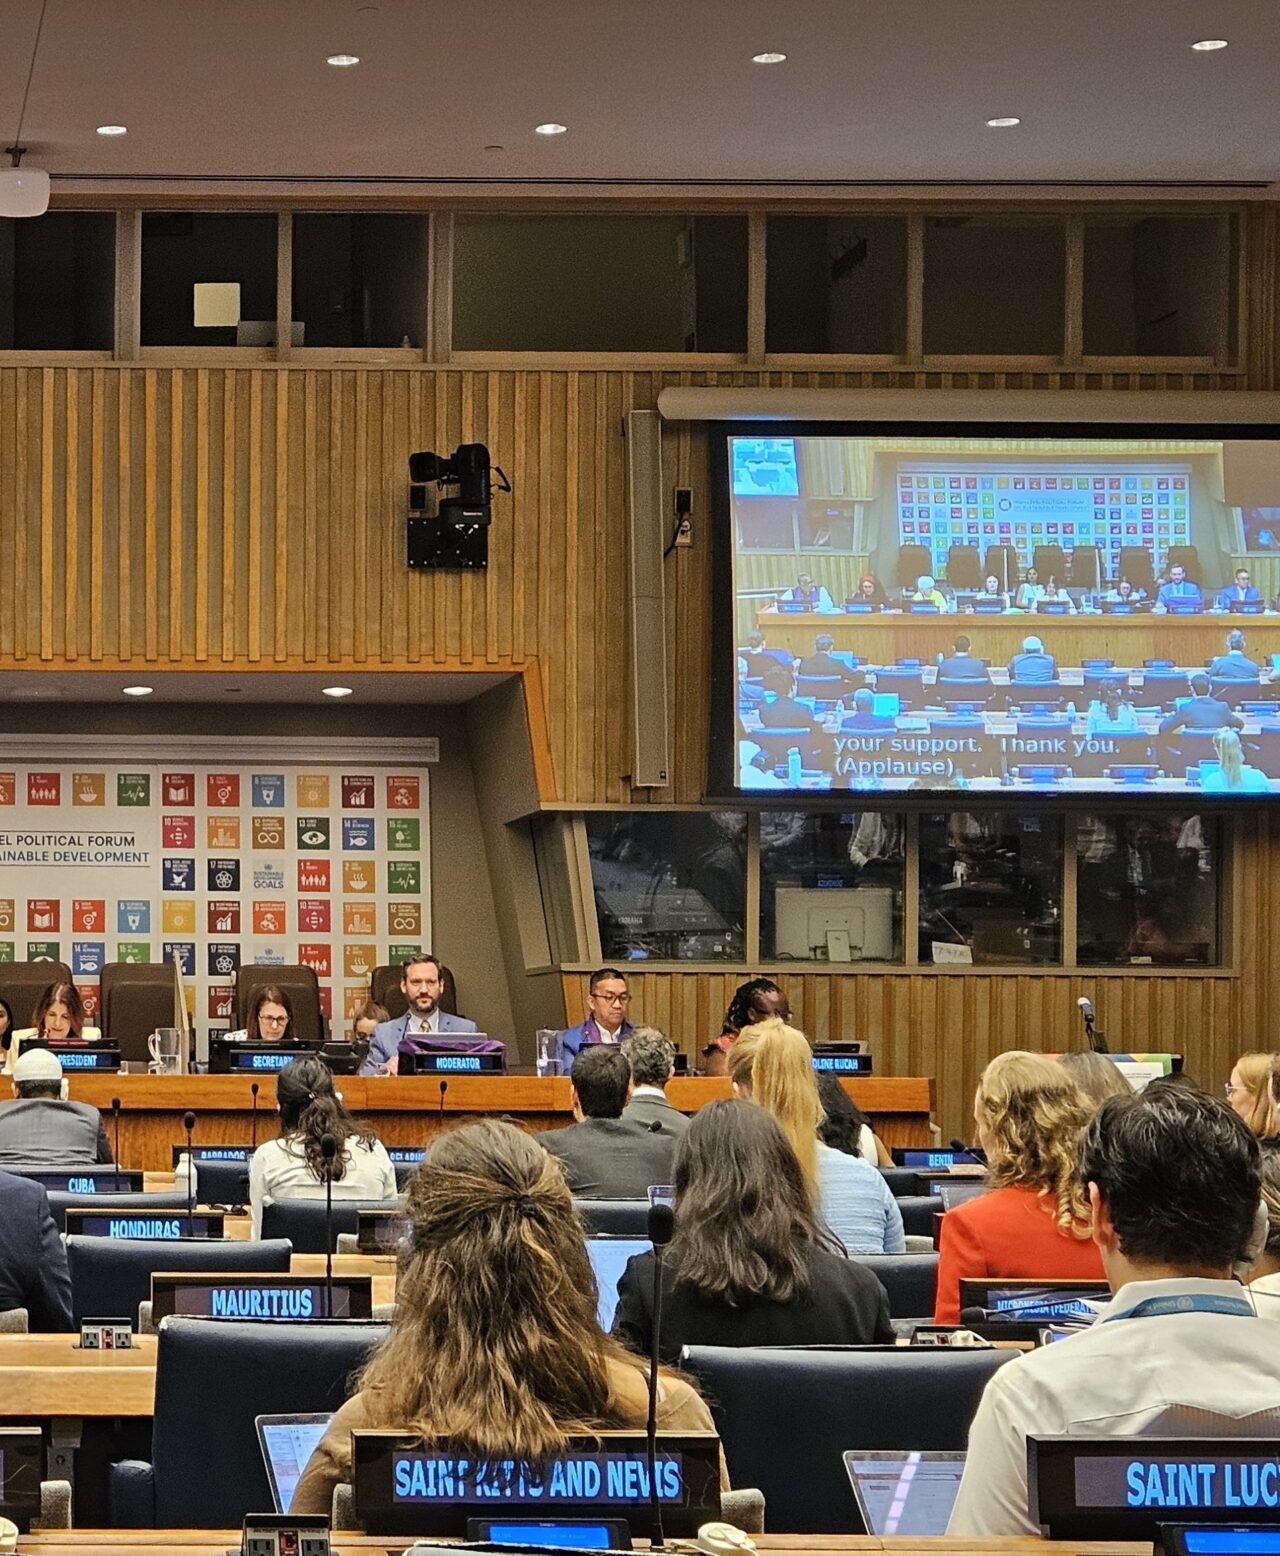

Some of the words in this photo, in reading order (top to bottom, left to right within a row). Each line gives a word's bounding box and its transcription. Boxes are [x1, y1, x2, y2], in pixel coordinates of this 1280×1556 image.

[834, 737, 883, 756] your
[891, 737, 983, 756] support.
[1001, 736, 1066, 753] Thank
[1073, 738, 1121, 757] you.
[835, 757, 955, 777] (Applause)
[16, 835, 84, 847] POLITICAL
[88, 836, 135, 847] FORUM
[53, 851, 150, 863] DEVELOPMENT
[253, 880, 284, 889] GOALS
[57, 1054, 97, 1067] PRESIDENT
[436, 1057, 481, 1069] MODERATOR
[812, 1058, 834, 1070] OLINE
[928, 1153, 954, 1167] BENIN
[68, 1177, 96, 1193] CUBA
[109, 1219, 180, 1239] HONDURAS
[212, 1288, 313, 1317] MAURITIUS
[394, 1459, 468, 1498] SAINT
[549, 1459, 601, 1498] AND
[607, 1460, 680, 1498] NEVIS
[1126, 1461, 1216, 1507] SAINT
[1224, 1462, 1280, 1507] LUC
